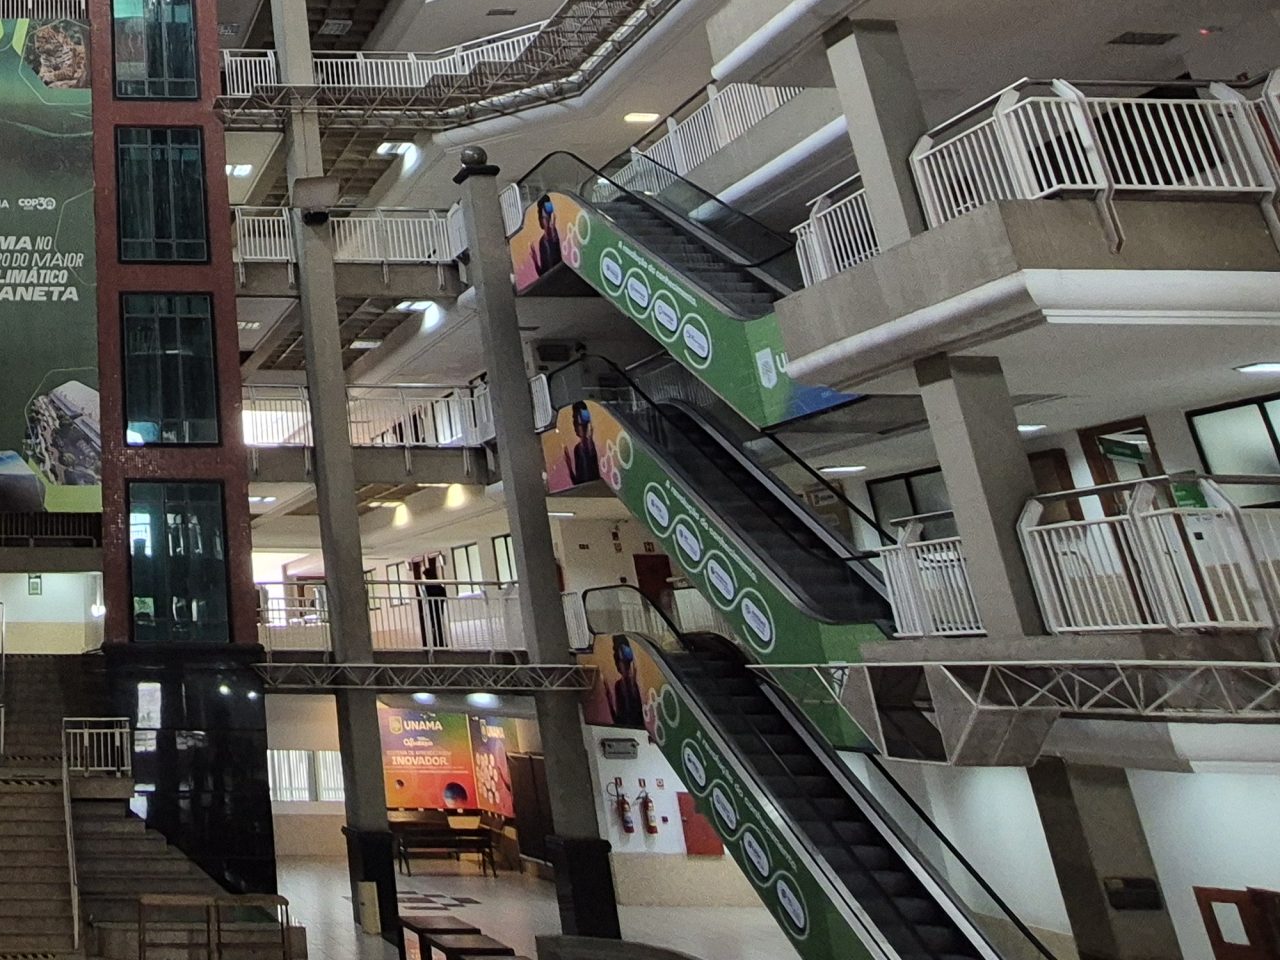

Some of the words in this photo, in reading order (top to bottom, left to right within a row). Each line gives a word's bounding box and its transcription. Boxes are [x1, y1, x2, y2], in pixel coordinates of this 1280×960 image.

[34, 235, 53, 250] NO
[11, 253, 29, 267] DO
[30, 253, 85, 267] MAIOR
[403, 720, 443, 731] UNAMA
[391, 756, 449, 766] INOVADOR
